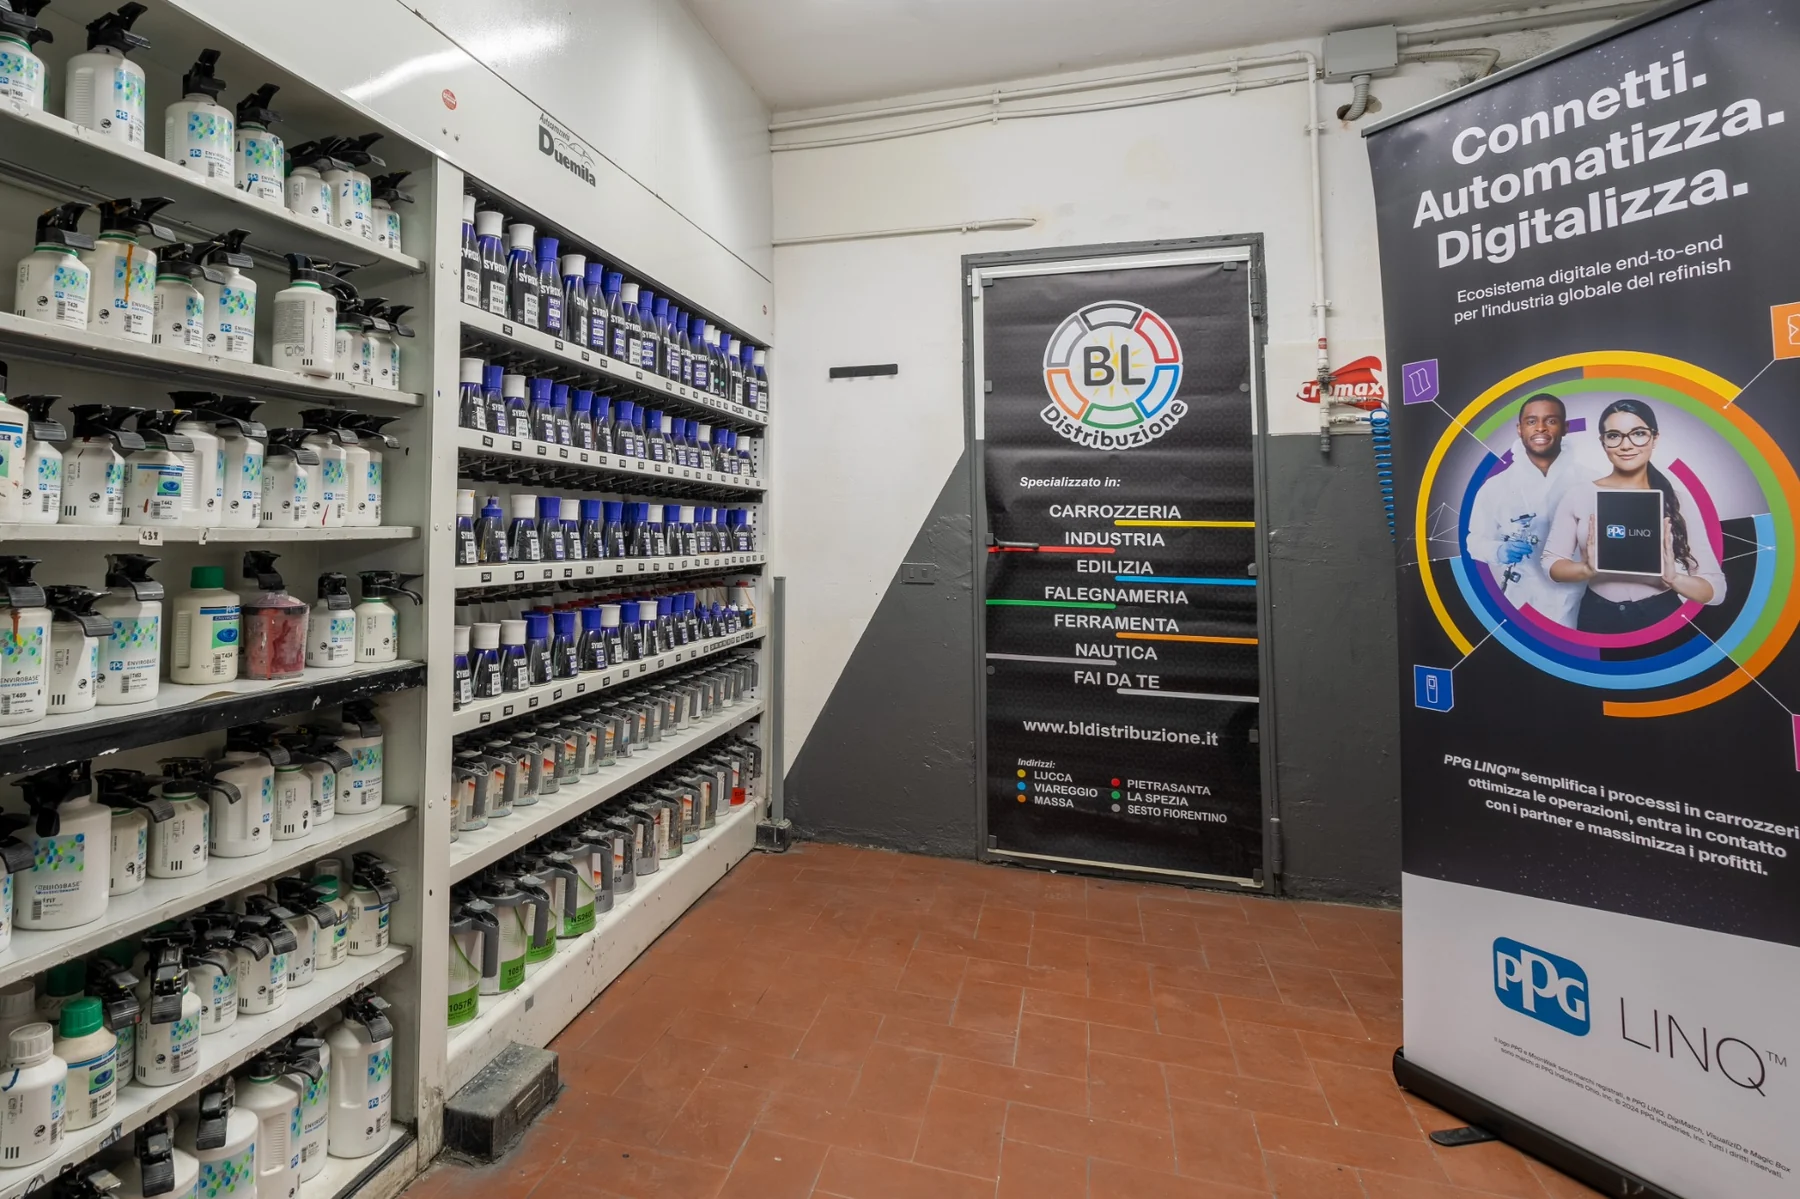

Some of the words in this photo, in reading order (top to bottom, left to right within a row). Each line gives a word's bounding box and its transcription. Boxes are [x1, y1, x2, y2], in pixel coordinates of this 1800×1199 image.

[1452, 49, 1707, 165] Connetti.
[539, 124, 596, 188] Duemila
[1412, 97, 1785, 229] Automatizza.
[1437, 167, 1749, 269] Digitalizza.
[1457, 275, 1545, 304] Ecosistema
[1548, 260, 1612, 287] digitale
[1615, 233, 1724, 271] end-to-end
[1453, 306, 1479, 325] per
[1481, 289, 1554, 318] l'industria
[1558, 274, 1622, 306] globale
[1626, 269, 1654, 291] del
[1659, 257, 1732, 286] refinish
[1083, 343, 1146, 387] BL
[1042, 401, 1185, 448] Distribuzione
[1019, 476, 1101, 490] Specializzato
[1104, 476, 1121, 488] in:
[1049, 504, 1182, 519] CARROZZERIA
[1065, 531, 1166, 547] INDUSTRIA
[1607, 526, 1624, 538] PPG
[1076, 560, 1154, 575] EDILIZIA
[1044, 586, 1189, 604] FALEGNAMERIA
[1054, 614, 1179, 633] FERRAMENTA
[1075, 642, 1158, 661] NAUTICA
[1074, 671, 1101, 685] FAI
[1106, 672, 1132, 687] DA
[1136, 674, 1160, 689] TE
[1022, 720, 1218, 746] www.bldistribuzione.it
[1017, 758, 1056, 769] Indirizzi:
[1034, 770, 1073, 783] LUCCA
[1443, 753, 1472, 770] PPG
[1520, 769, 1598, 797] semplifica
[1600, 785, 1605, 798] i
[1608, 787, 1680, 814] processi
[1684, 802, 1702, 818] in
[1034, 782, 1098, 798] VIAREGGIO
[1127, 779, 1211, 796] PIETRASANTA
[1034, 795, 1074, 808] MASSA
[1127, 791, 1142, 803] LA
[1145, 793, 1188, 807] SPEZIA
[1127, 804, 1162, 818] SESTO
[1163, 808, 1228, 824] FIORENTINO
[1468, 776, 1531, 800] ottimizza
[1532, 789, 1546, 803] le
[1548, 794, 1634, 826] operazioni,
[1636, 813, 1682, 835] entra
[1685, 824, 1702, 839] in
[1705, 830, 1787, 858] contatto
[1485, 798, 1511, 813] con
[1513, 802, 1518, 814] i
[1520, 805, 1572, 829] partner
[1575, 820, 1585, 830] e
[1588, 822, 1686, 856] massimizza
[1688, 845, 1694, 858] i
[1698, 848, 1768, 876] profitti.
[1495, 944, 1587, 1025] PPG
[449, 998, 472, 1013] 1057R
[1498, 1038, 1510, 1048] logo
[1510, 1044, 1523, 1054] PPG
[1558, 1065, 1573, 1076] sono
[1574, 1072, 1594, 1086] marchi
[1632, 1098, 1646, 1108] PPG
[1667, 1113, 1704, 1135] DigiMatch,
[1705, 1131, 1742, 1151] VisualizID
[1750, 1150, 1774, 1166] Magic
[1775, 1161, 1791, 1172] Box
[1500, 1047, 1514, 1057] sono
[1514, 1054, 1534, 1066] marchi
[1541, 1065, 1554, 1075] PPG
[1622, 1101, 1639, 1114] 2024
[1640, 1110, 1655, 1121] PPG
[1708, 1140, 1724, 1152] Tutti
[1729, 1150, 1748, 1164] diritti
[1750, 1160, 1784, 1180] riservati.
